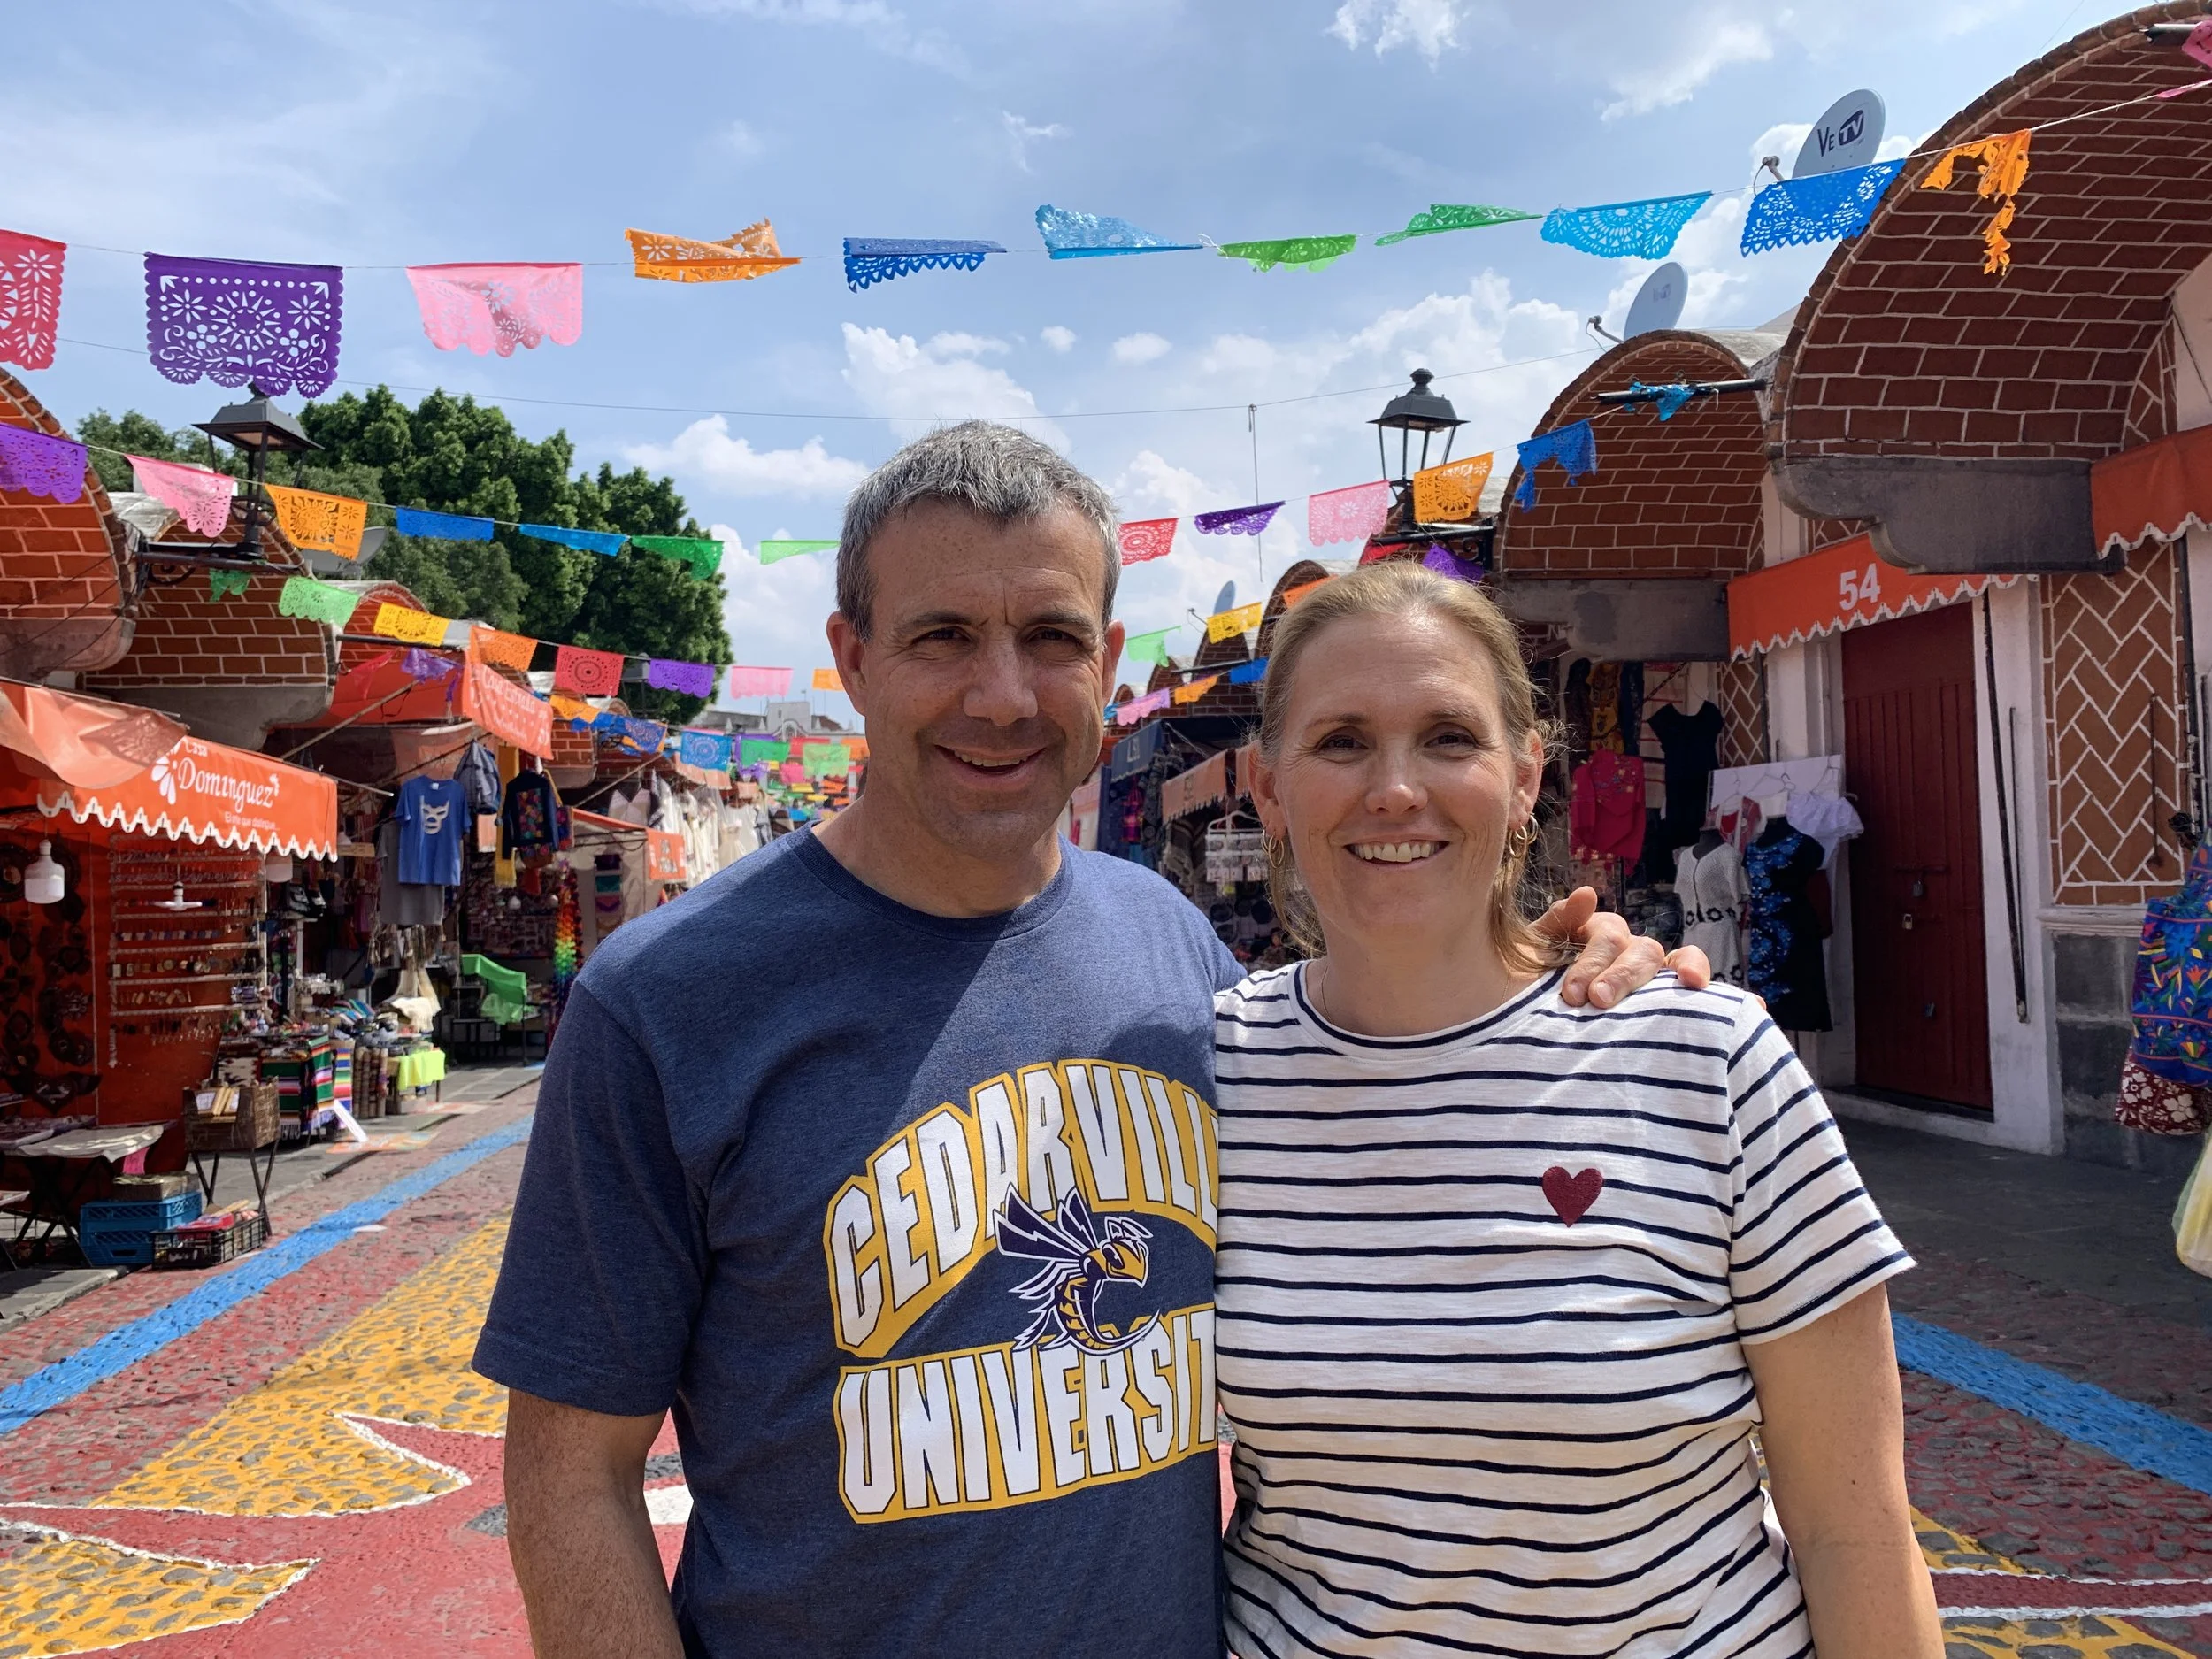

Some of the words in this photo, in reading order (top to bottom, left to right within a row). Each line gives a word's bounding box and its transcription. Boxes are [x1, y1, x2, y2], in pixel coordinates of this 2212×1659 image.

[1839, 562, 1881, 611] 54
[826, 1060, 1218, 1356] CEDARVILL
[834, 1306, 1217, 1524] UNIVERSIT
